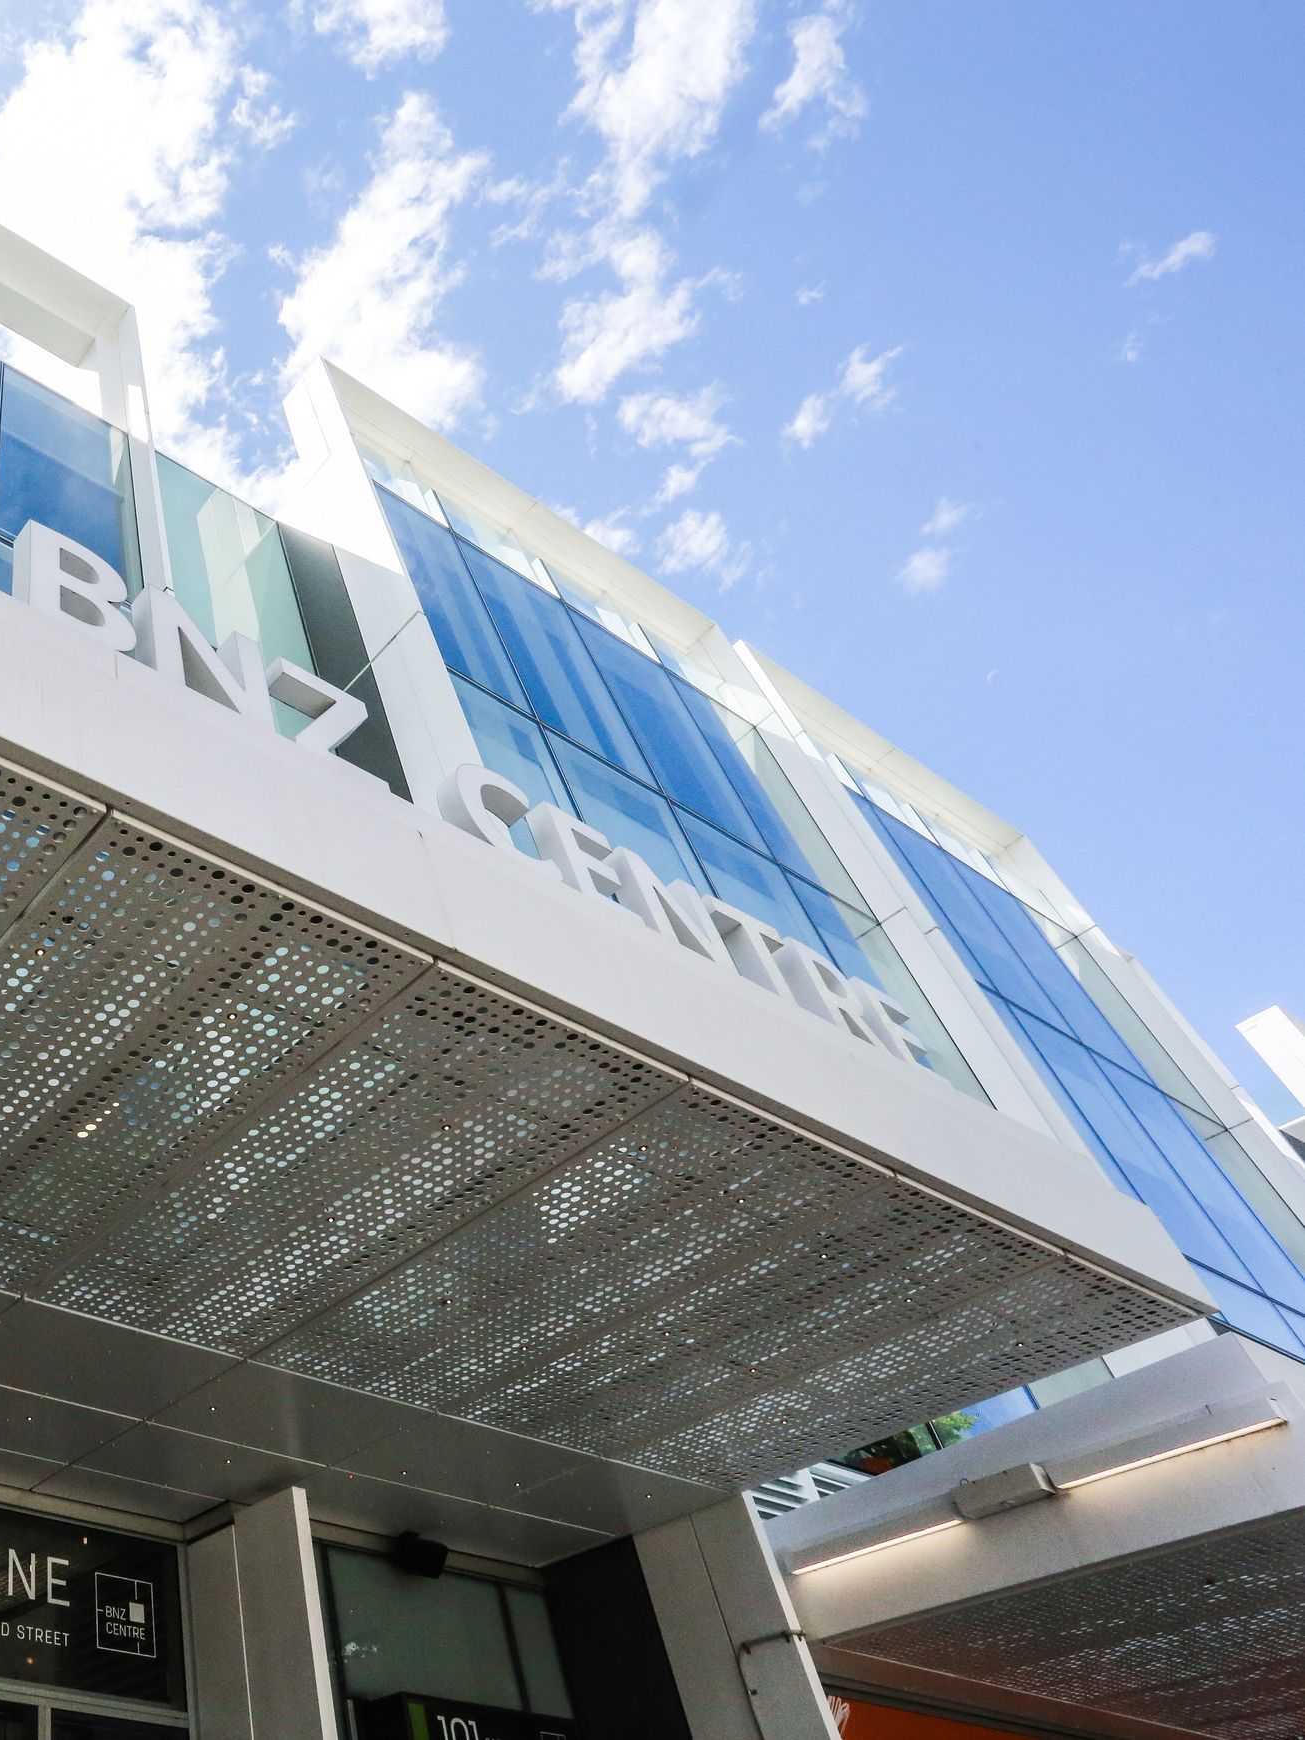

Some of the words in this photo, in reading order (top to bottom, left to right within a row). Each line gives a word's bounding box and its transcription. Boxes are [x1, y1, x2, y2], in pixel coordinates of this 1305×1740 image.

[12, 518, 379, 778] BNZ
[437, 763, 937, 1074] CENTRE
[105, 1605, 126, 1620] BNZ
[16, 1624, 70, 1647] STREET
[105, 1621, 146, 1640] CENTRE
